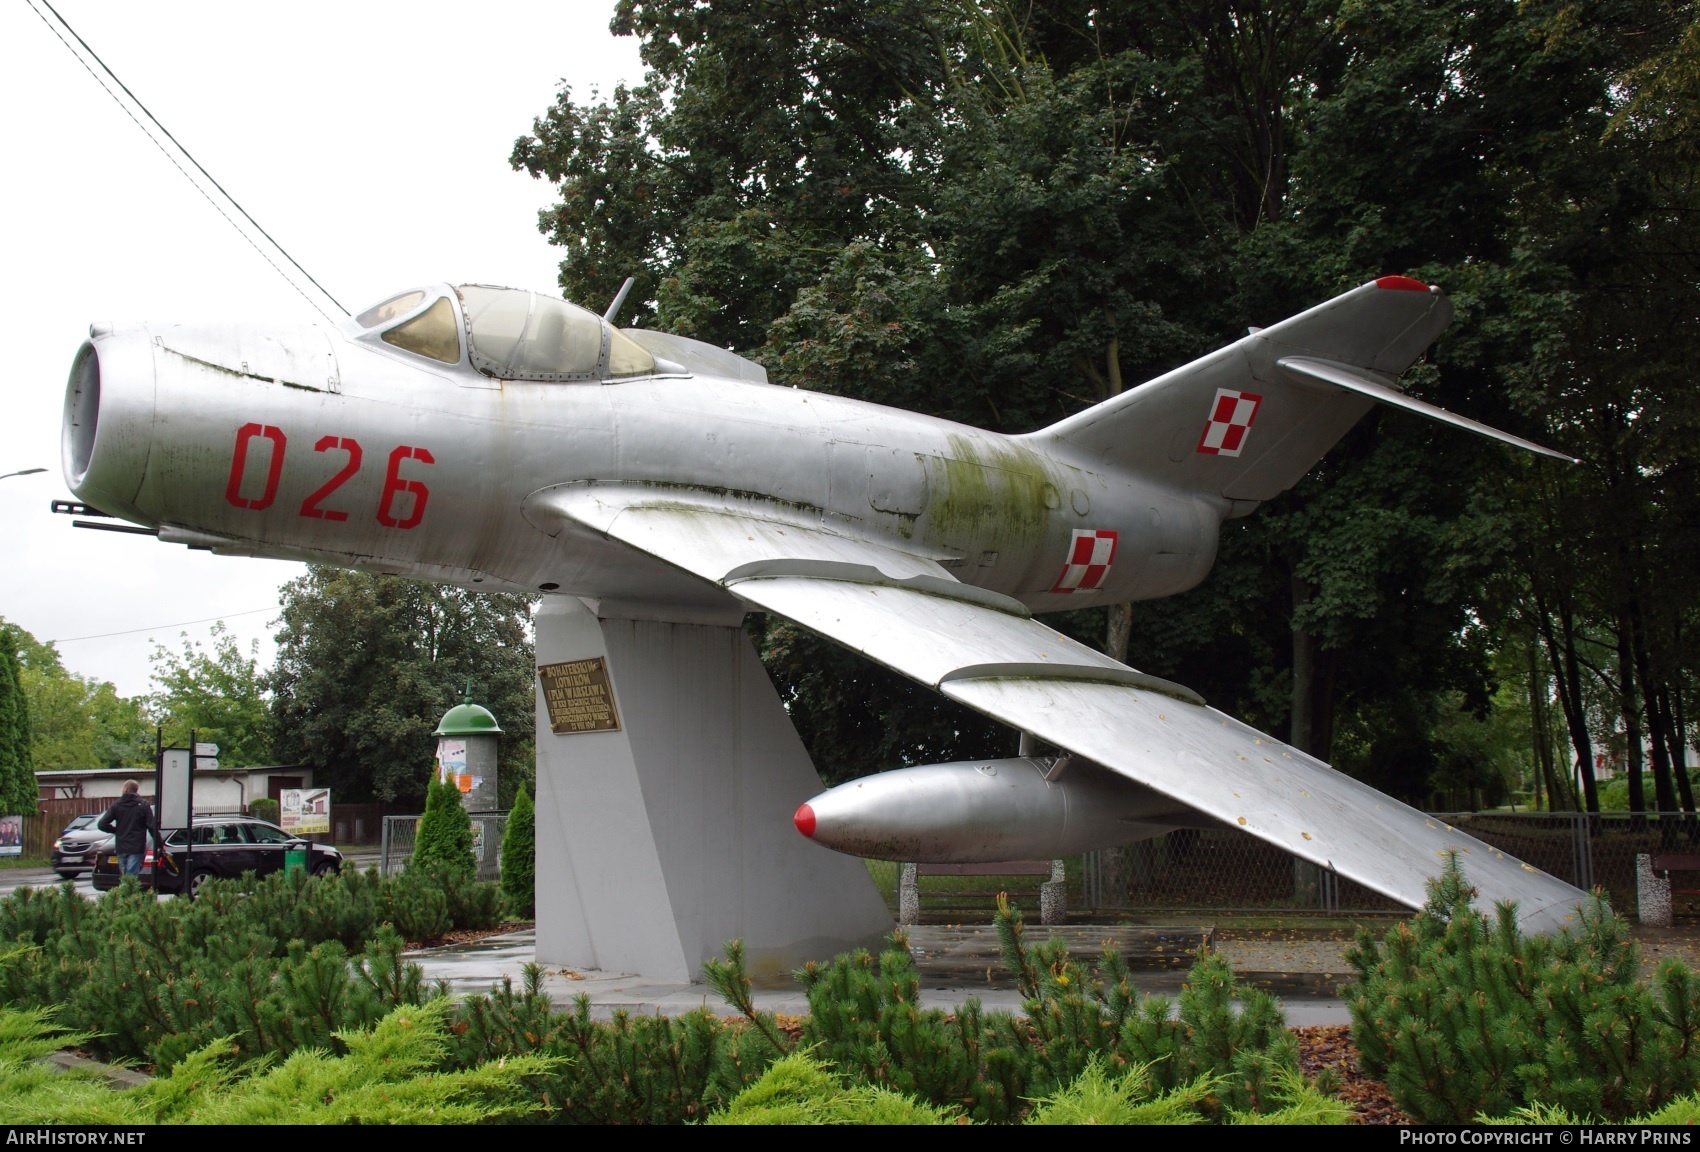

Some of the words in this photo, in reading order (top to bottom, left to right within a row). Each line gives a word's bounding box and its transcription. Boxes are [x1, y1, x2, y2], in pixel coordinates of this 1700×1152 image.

[227, 422, 436, 530] 026
[546, 661, 595, 677] BOHATERSKIM
[564, 684, 606, 699] WARSZAWA
